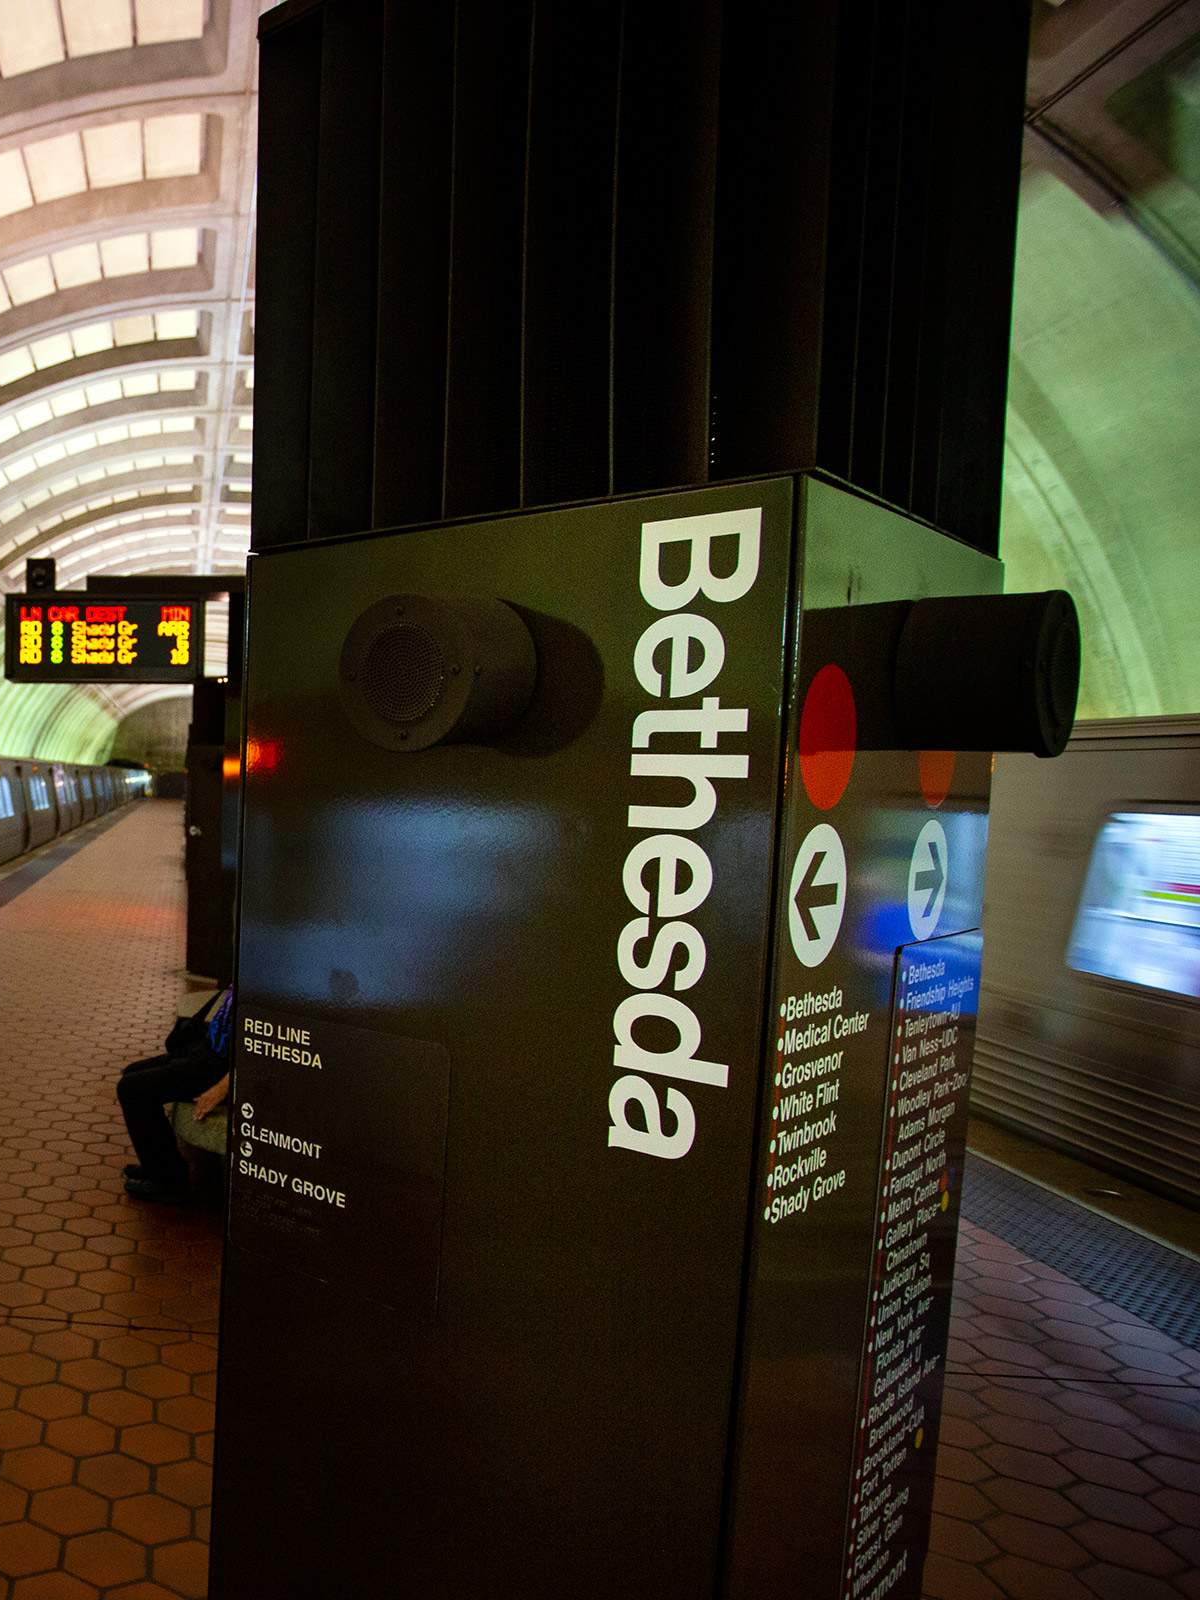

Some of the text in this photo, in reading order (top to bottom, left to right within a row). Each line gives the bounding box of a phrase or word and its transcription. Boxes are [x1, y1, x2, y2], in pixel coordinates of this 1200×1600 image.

[20, 606, 191, 622] LN CAR DEST MIN
[20, 621, 190, 636] RD 8 Shady Gr ARR
[20, 635, 42, 650] RD
[51, 635, 63, 650] 8
[71, 635, 115, 650] Shady
[117, 635, 138, 650] Gr
[20, 649, 42, 664] RD
[51, 649, 63, 664] 8
[71, 649, 115, 664] Shady
[117, 649, 137, 664] Gr
[608, 507, 763, 1160] Bethesda
[908, 959, 945, 985] Bethesda
[786, 985, 843, 1022] Bethesda
[906, 975, 974, 1012] Friendship Heights
[244, 1018, 310, 1046] RED LINE
[784, 1011, 870, 1055] Medical Center
[905, 1002, 961, 1038] Tenleytown-AU
[244, 1037, 322, 1069] BETHESDA
[782, 1051, 844, 1089] Grosvenor
[900, 1052, 956, 1091] Cleveland Park
[902, 1045, 917, 1065] Van
[780, 1079, 840, 1122] White Flint
[897, 1089, 932, 1118] Woodley
[241, 1122, 322, 1159] GLENMONT
[777, 1110, 837, 1156] Twinbrook
[898, 1102, 956, 1143] Adams Morgan
[773, 1147, 827, 1191] Rockville
[892, 1128, 946, 1171] Dupont Circle
[239, 1160, 345, 1208] SHADY GROVE
[890, 1149, 947, 1197] Farragut North
[771, 1170, 846, 1224] Shady Grove
[887, 1179, 940, 1223] Metro Center
[885, 1219, 915, 1248] Gallery
[886, 1232, 928, 1271] Chinatown
[881, 1252, 930, 1300] Judiciary Sq
[877, 1274, 932, 1325] Union Station
[875, 1326, 895, 1351] New
[897, 1307, 914, 1333] York
[876, 1339, 905, 1374] Florida
[914, 1343, 922, 1363] U
[867, 1391, 895, 1427] Rhode
[897, 1366, 921, 1400] Island
[869, 1394, 914, 1449] Brentwood
[860, 1447, 907, 1502] Fort Totten
[856, 1486, 909, 1550] Silver Spring
[860, 1484, 892, 1524] Takoma
[854, 1514, 903, 1576] Forest Glen
[853, 1549, 890, 1598] Wheaton
